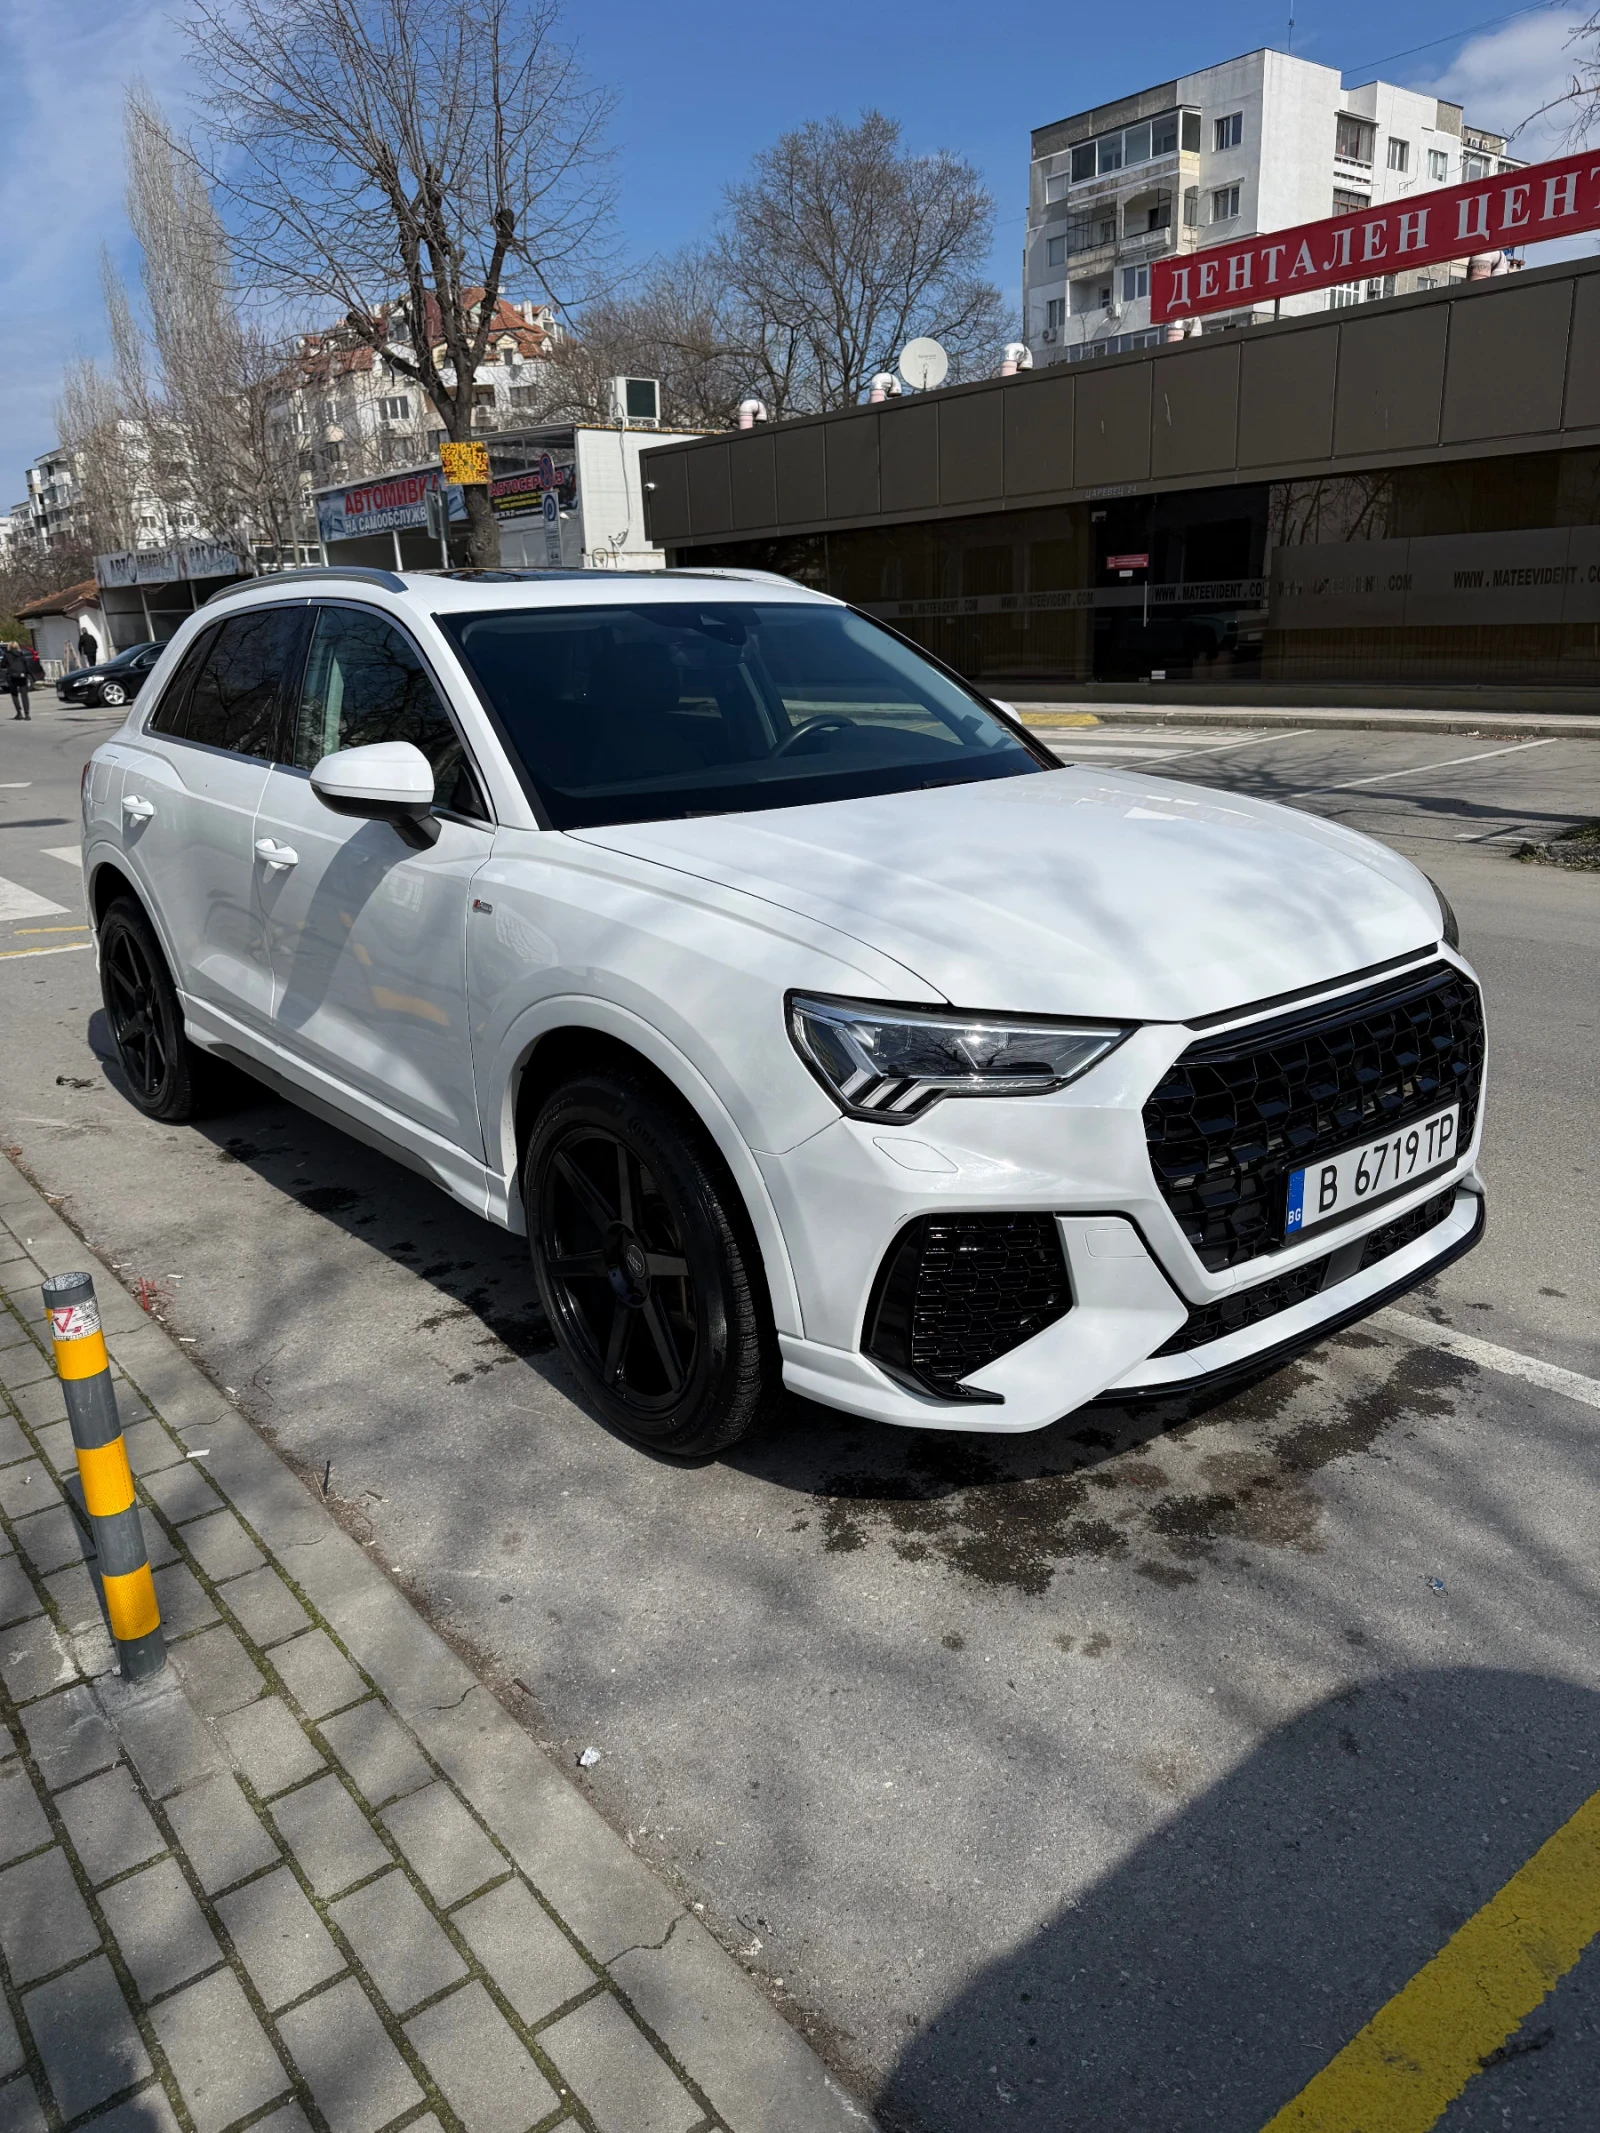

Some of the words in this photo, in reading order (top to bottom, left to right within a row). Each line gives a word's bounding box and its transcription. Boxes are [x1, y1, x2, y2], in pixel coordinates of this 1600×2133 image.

[1166, 207, 1432, 314] ДЕНТАЛЕН
[490, 471, 564, 497] АВТОСЕРЗ
[358, 506, 427, 533] САМООБСЛУЖВ
[1319, 1164, 1338, 1213] B
[1354, 1130, 1420, 1196] 6719
[1425, 1113, 1454, 1164] TP
[1287, 1207, 1302, 1226] BG
